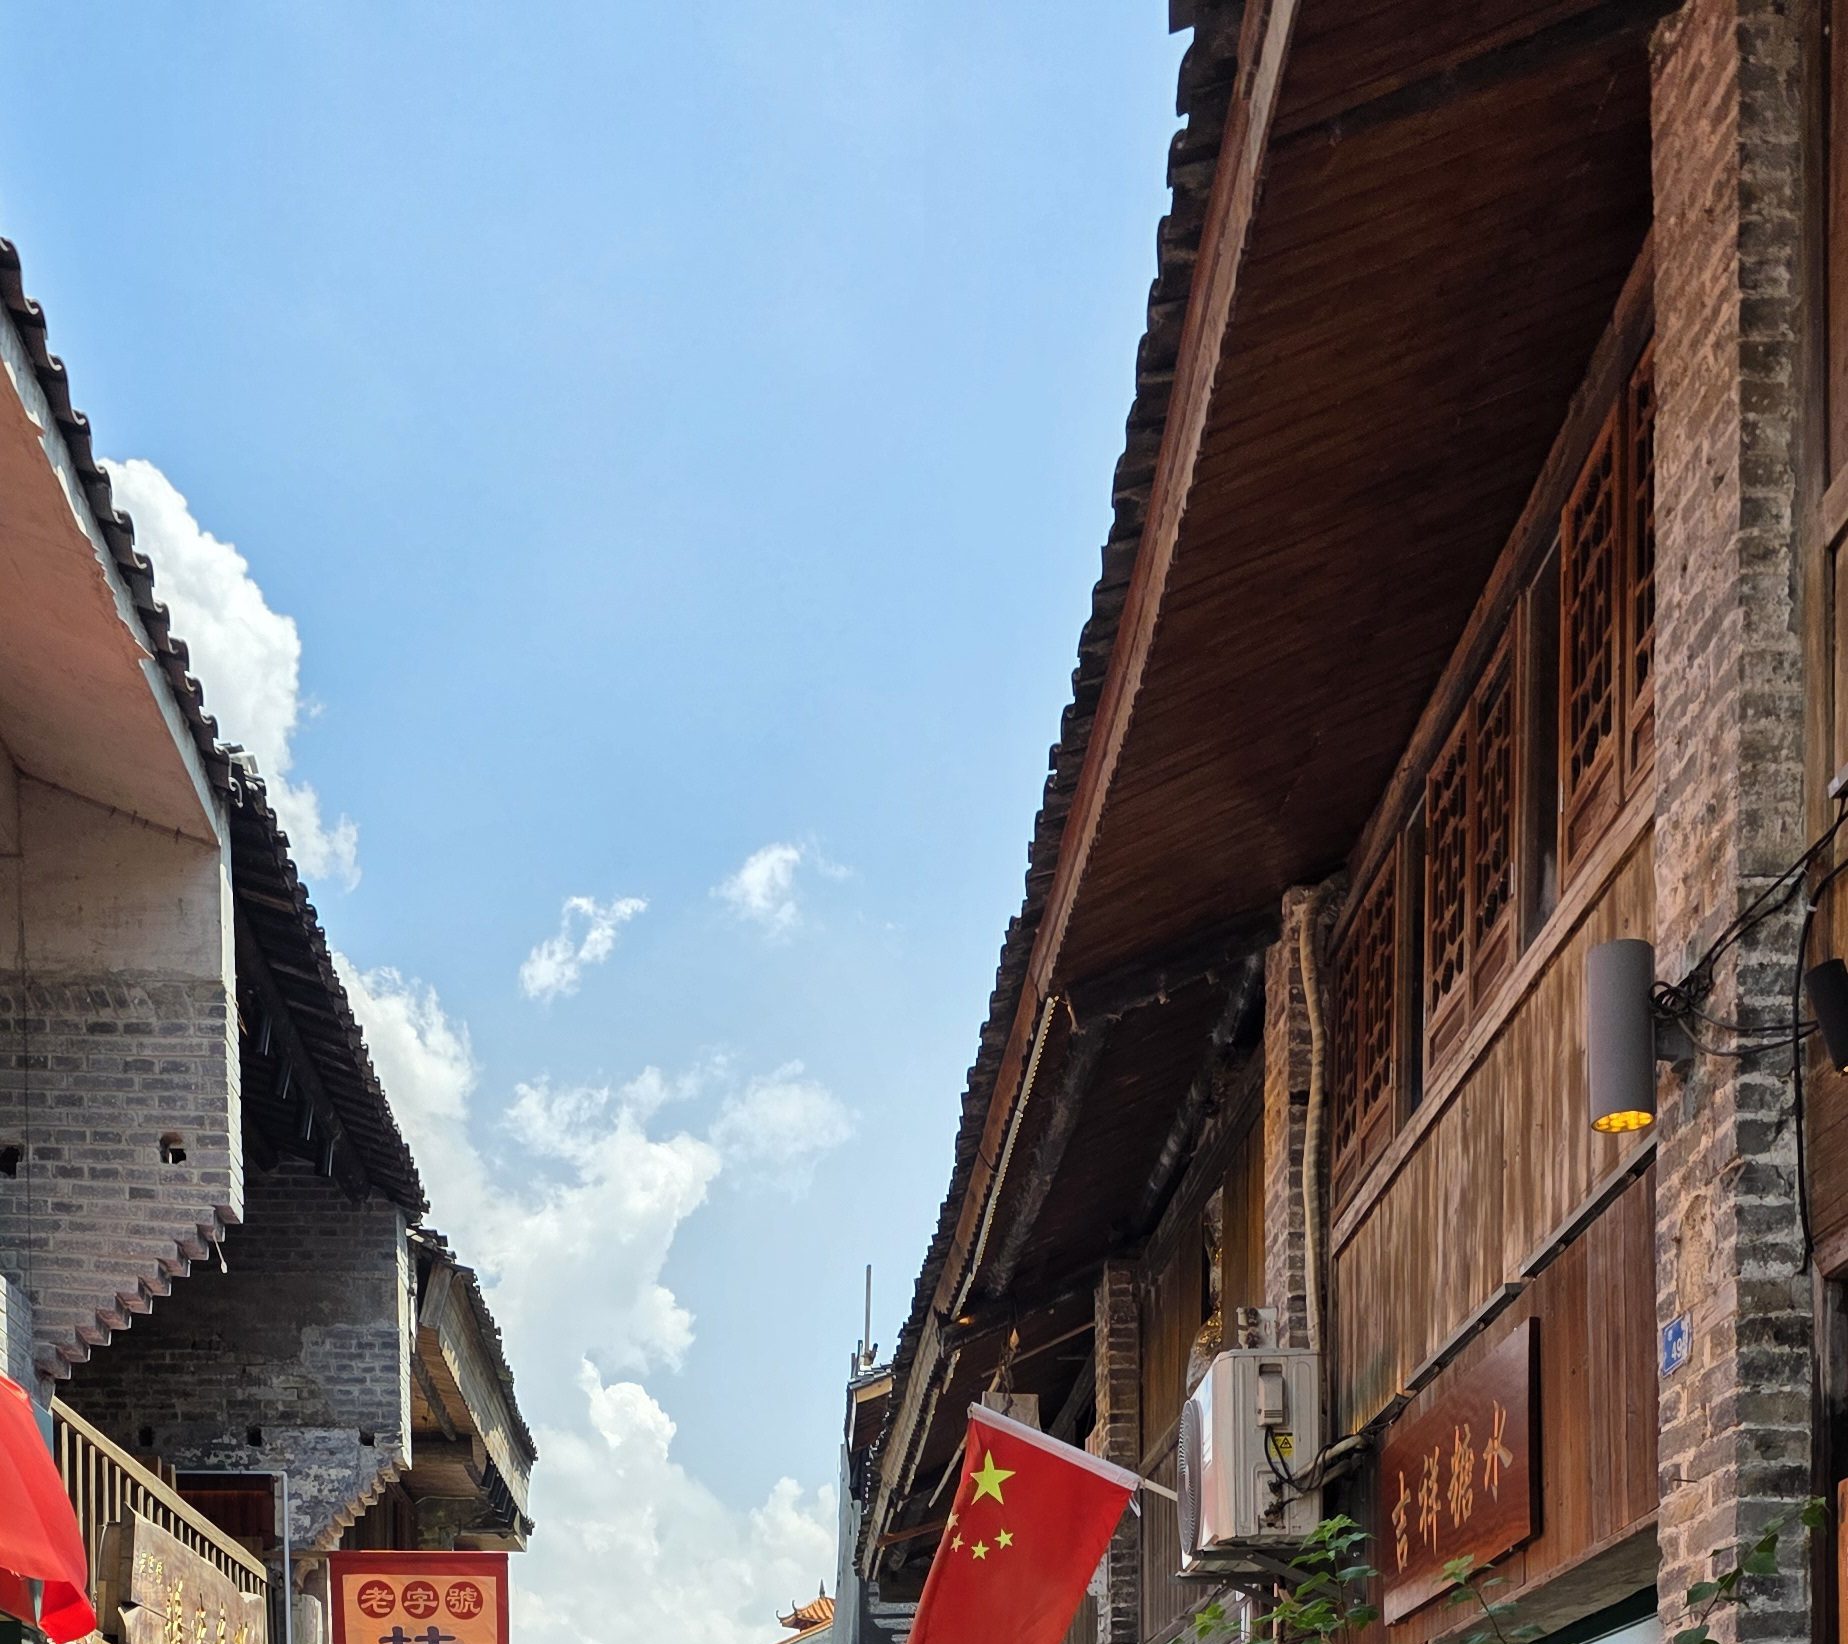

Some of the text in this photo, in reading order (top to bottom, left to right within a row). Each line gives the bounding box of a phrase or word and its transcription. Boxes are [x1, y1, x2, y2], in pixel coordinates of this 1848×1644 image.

[1391, 1399, 1514, 1575] 吉祥糖水
[360, 1585, 482, 1616] 老字號
